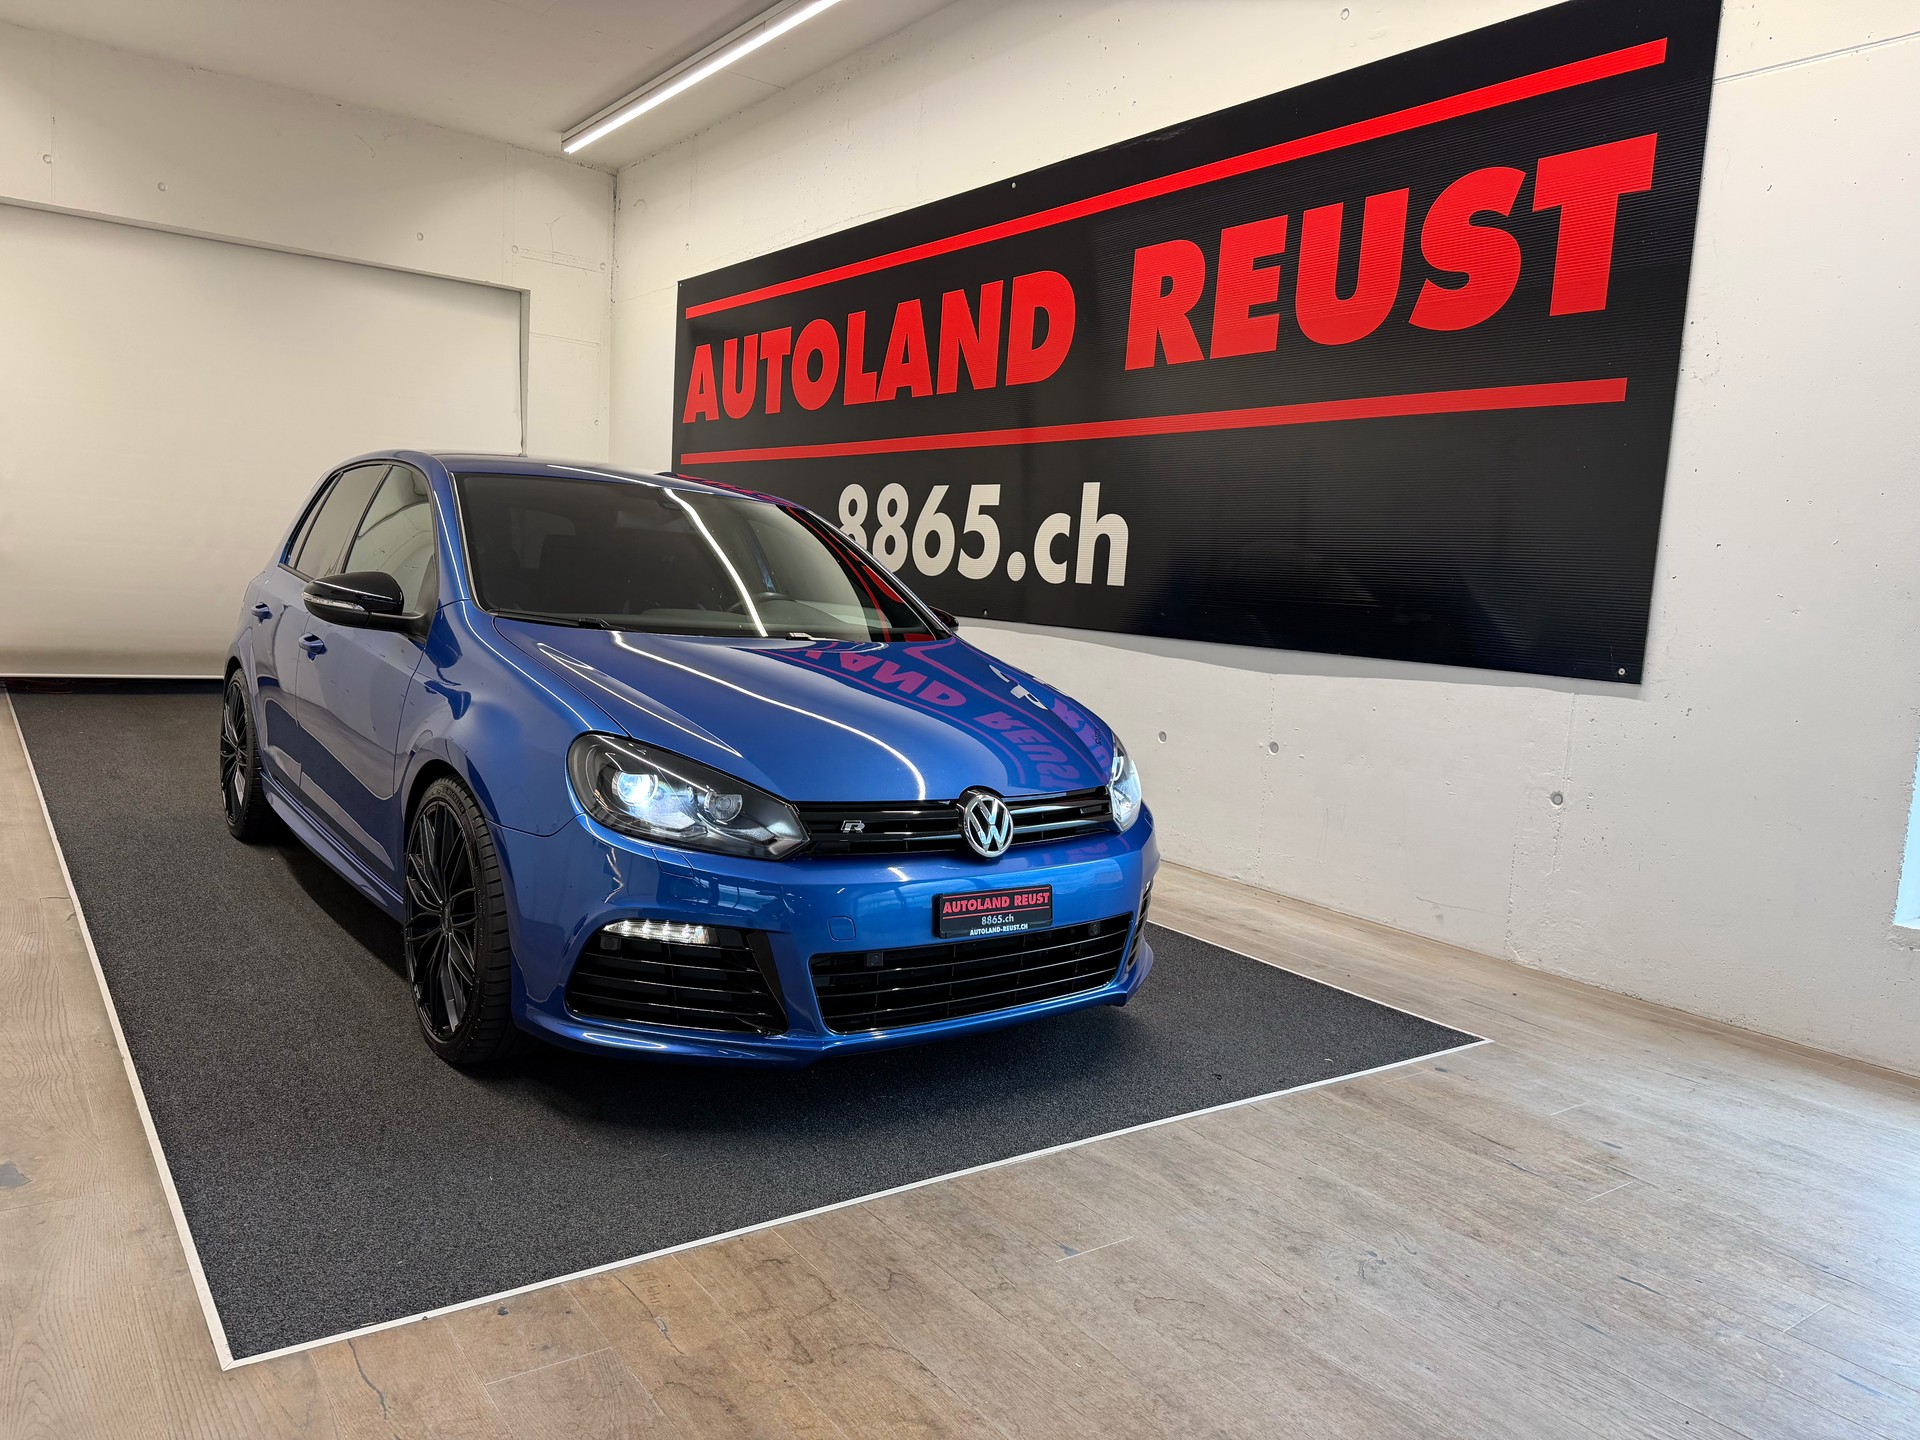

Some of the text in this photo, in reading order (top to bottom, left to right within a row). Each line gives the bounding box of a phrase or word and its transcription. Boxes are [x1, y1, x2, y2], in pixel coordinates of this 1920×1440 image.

[682, 134, 1658, 424] AUTOLAND REUST
[838, 481, 1129, 586] 8865.ch
[841, 820, 866, 834] R
[943, 892, 1050, 914] AUTOLAND REUST
[981, 914, 1014, 926] 8865.ch
[969, 923, 1028, 936] AUTOLAND-REUST.CH
